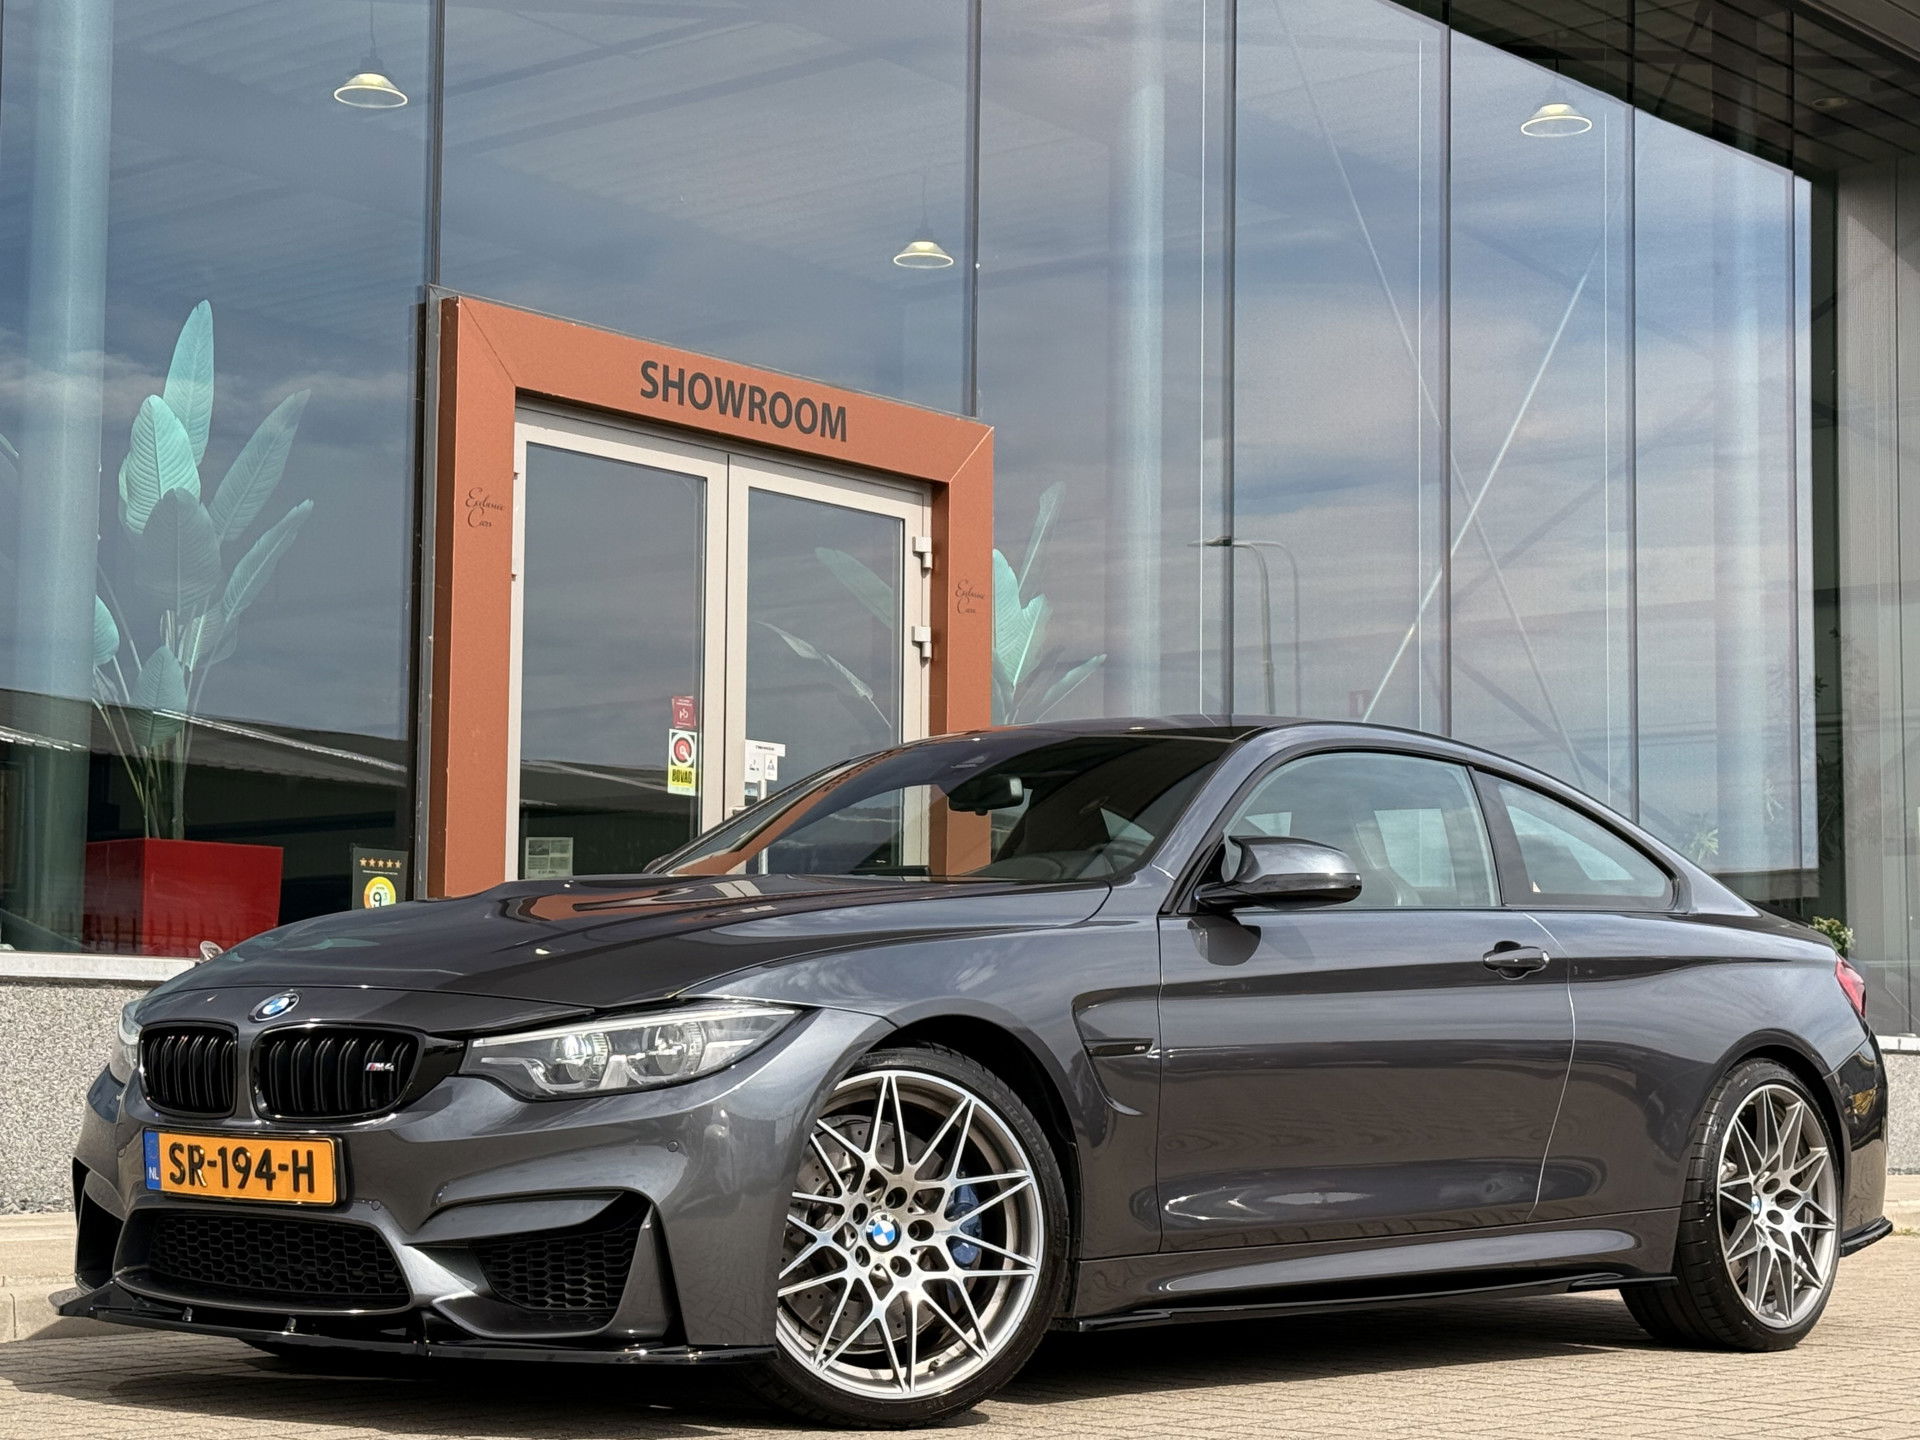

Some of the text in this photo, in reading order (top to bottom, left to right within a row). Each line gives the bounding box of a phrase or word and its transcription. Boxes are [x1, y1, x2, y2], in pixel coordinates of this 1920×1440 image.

[640, 360, 847, 442] SHOWROOM
[671, 768, 693, 785] BOVAG
[148, 1141, 315, 1194] NL SR-194-H
